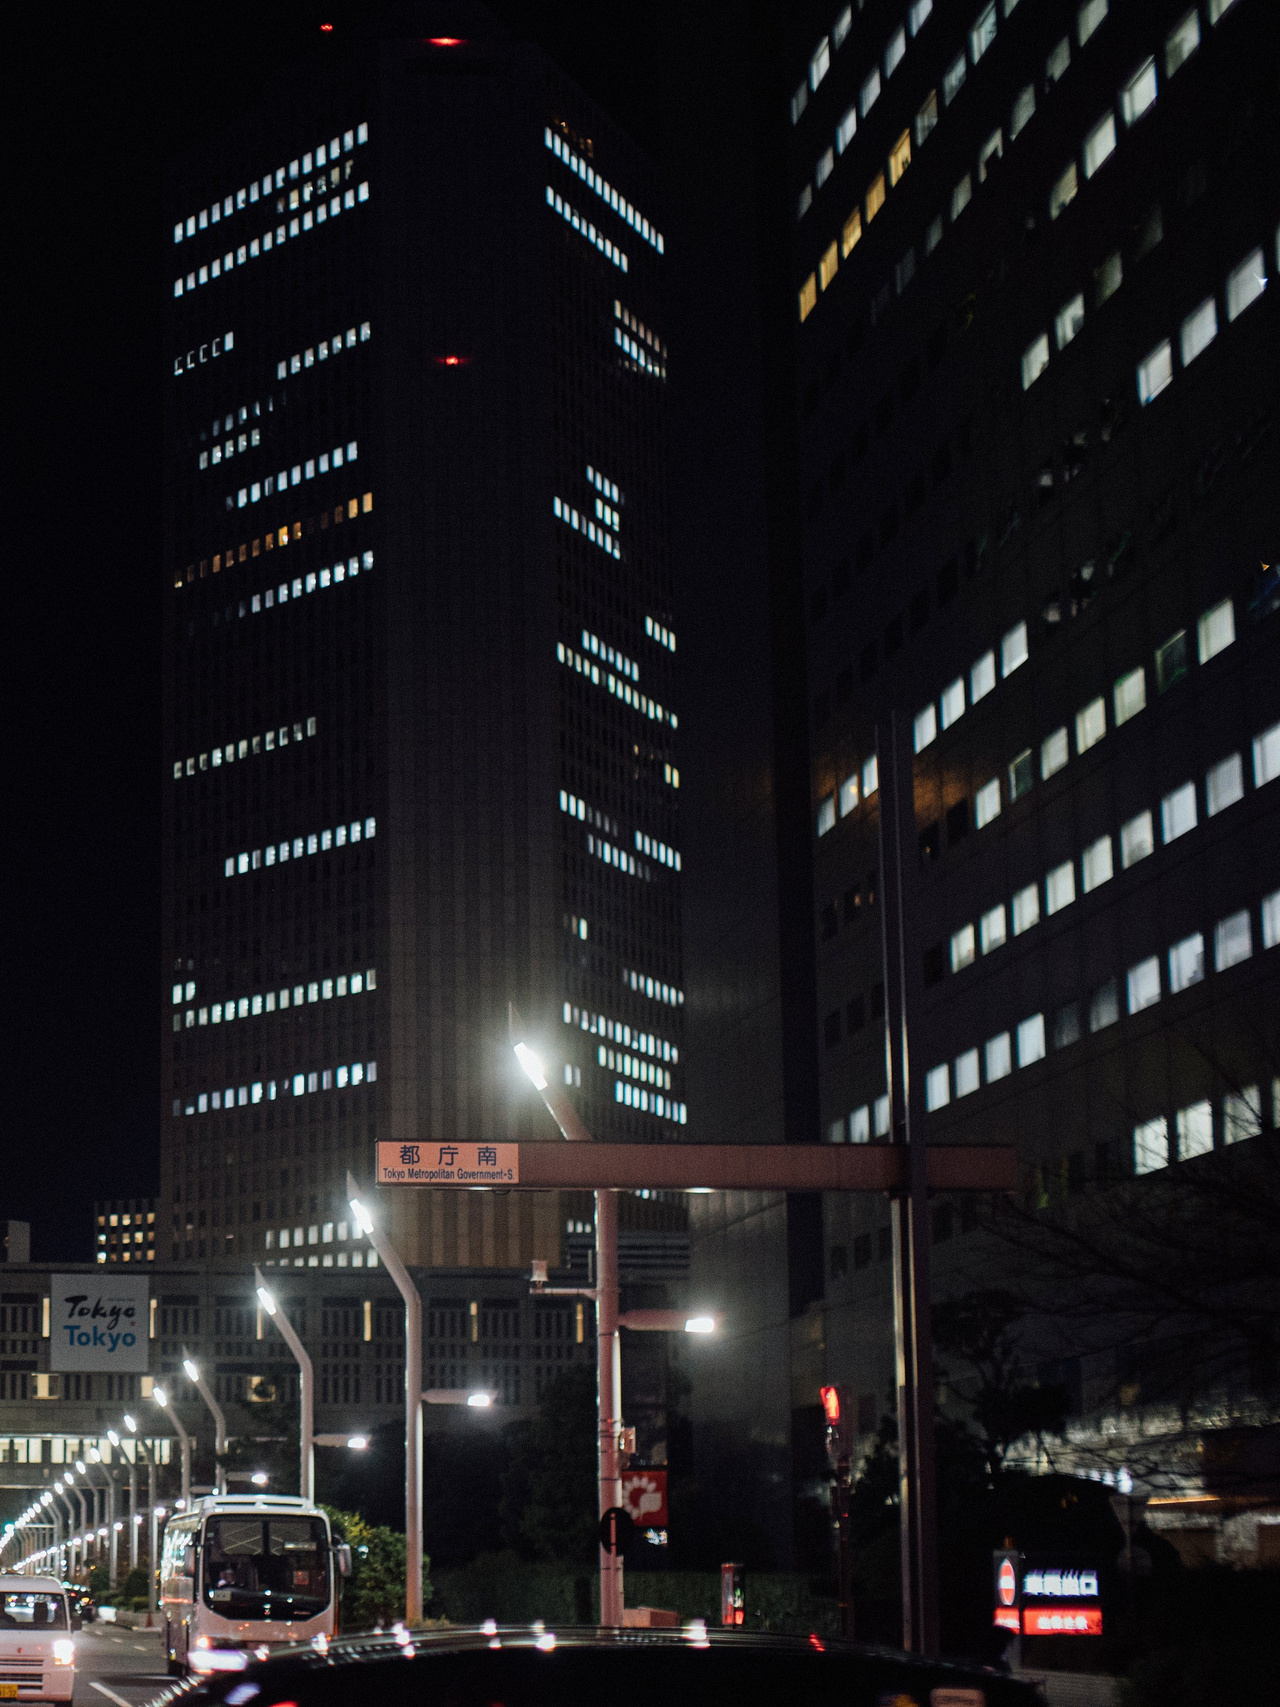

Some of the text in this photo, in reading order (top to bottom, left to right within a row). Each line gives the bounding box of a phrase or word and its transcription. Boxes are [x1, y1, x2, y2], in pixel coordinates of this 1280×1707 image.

[400, 1145, 497, 1166] 都庁南
[383, 1168, 405, 1180] Tokyo
[408, 1168, 454, 1181] Metropolitan
[64, 1295, 135, 1330] Tokyo
[63, 1325, 136, 1352] Tokyo
